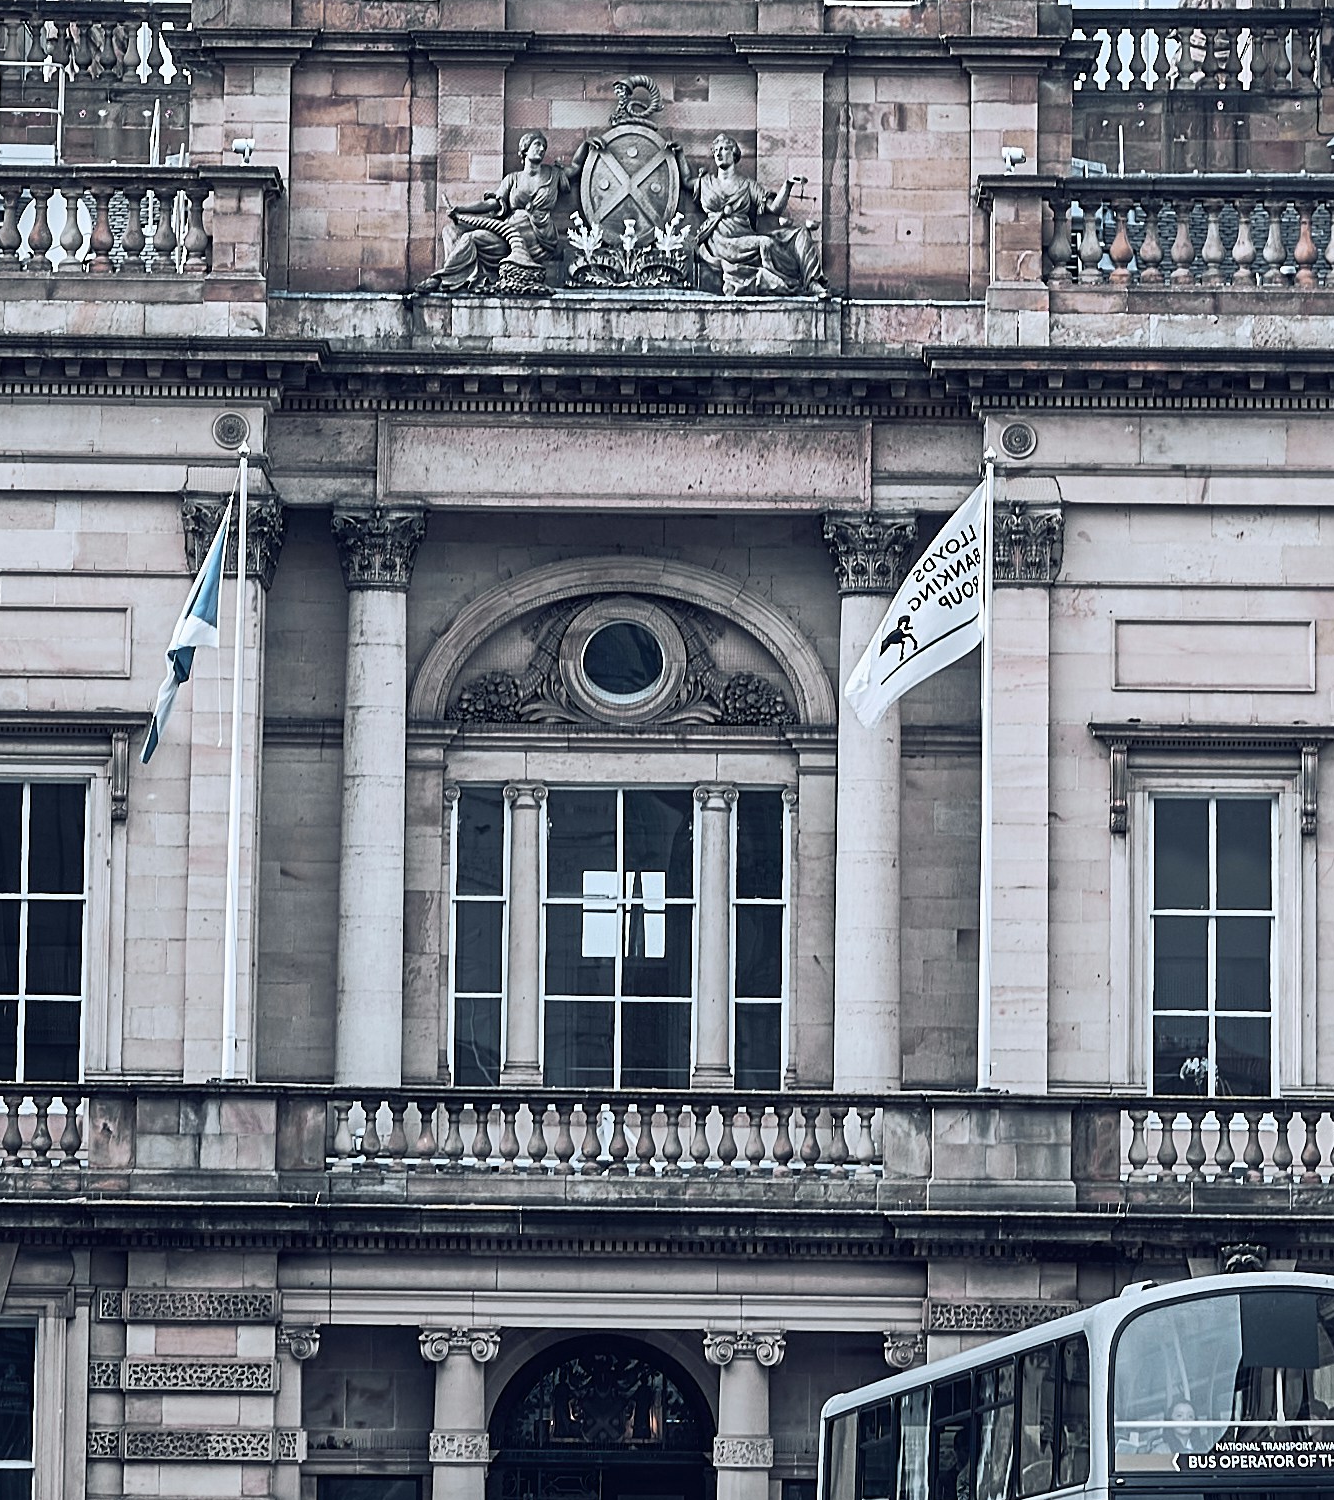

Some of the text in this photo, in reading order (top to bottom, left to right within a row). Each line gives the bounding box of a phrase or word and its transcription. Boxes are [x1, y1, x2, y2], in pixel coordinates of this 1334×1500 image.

[1215, 1441, 1261, 1451] NATIONAL
[1261, 1441, 1314, 1451] TRANSPORT
[1188, 1454, 1218, 1469] BUS
[1219, 1453, 1296, 1469] OPERATOR
[1297, 1453, 1317, 1468] OF
